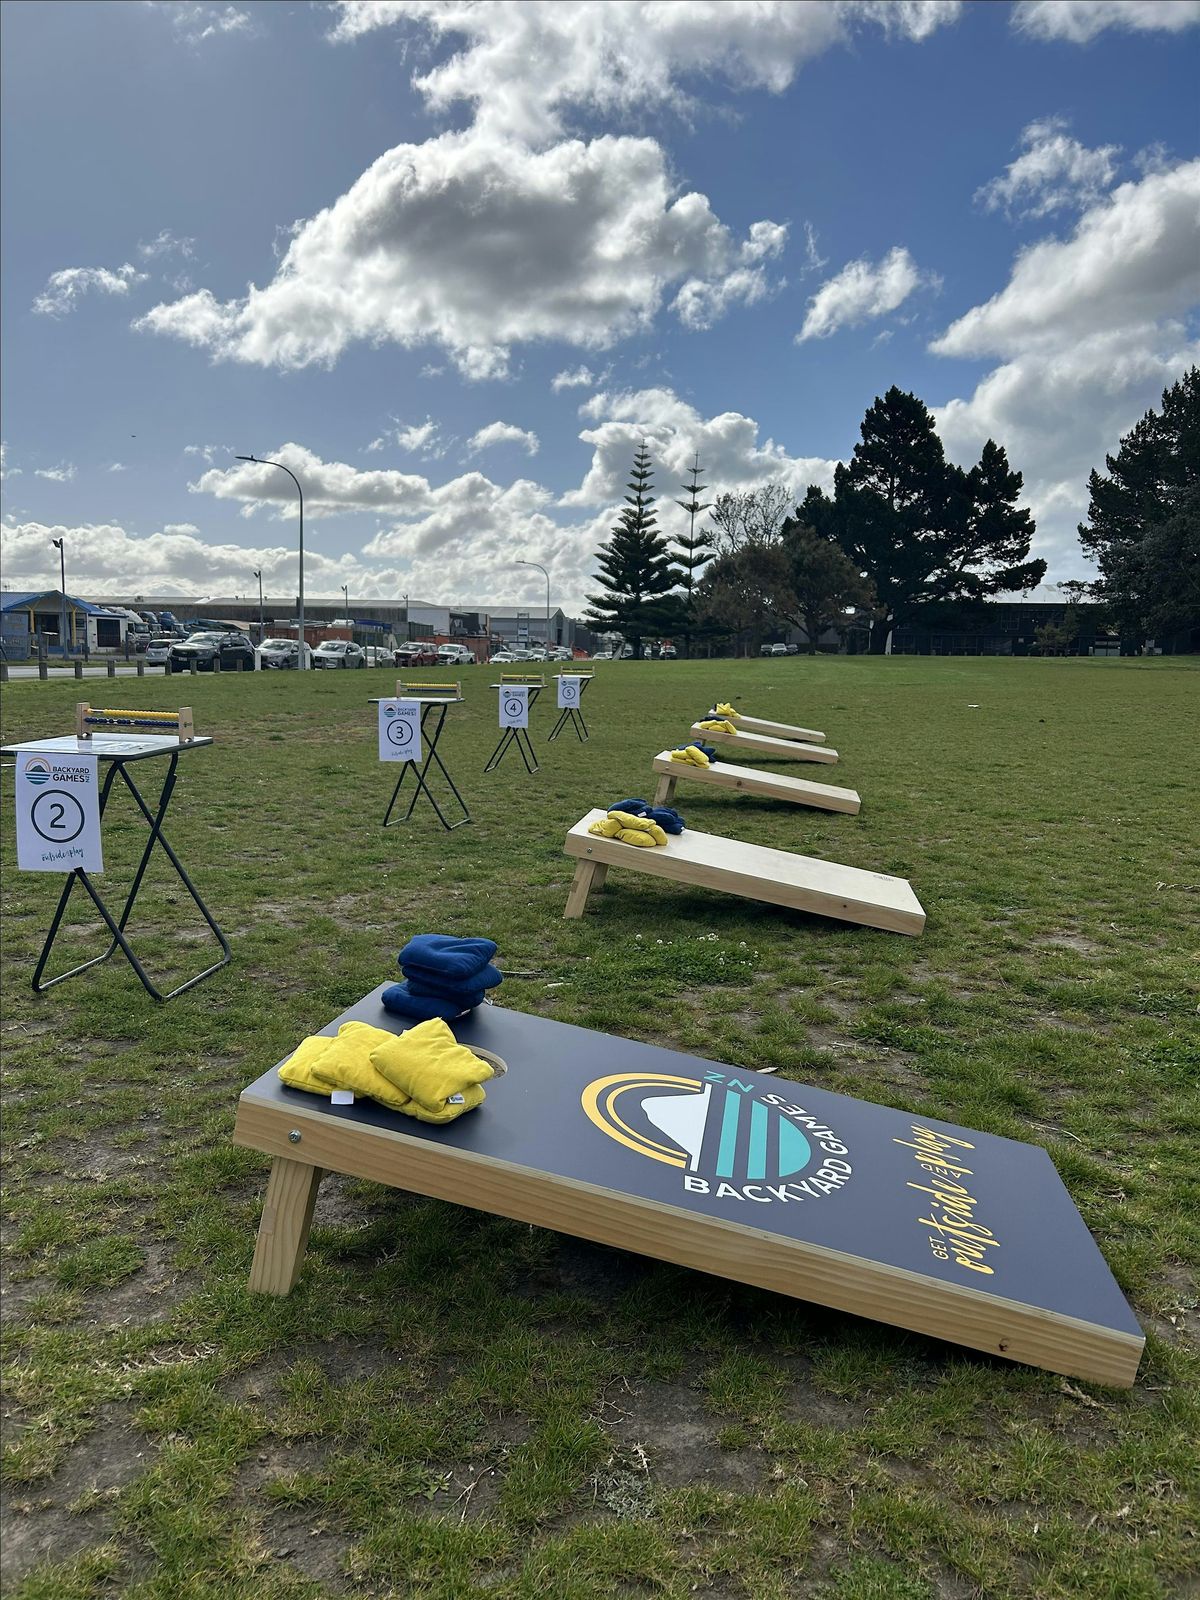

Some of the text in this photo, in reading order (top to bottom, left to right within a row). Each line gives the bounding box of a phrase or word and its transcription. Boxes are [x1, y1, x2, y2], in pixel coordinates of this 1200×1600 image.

[510, 703, 517, 712] 4
[396, 726, 404, 739] 3
[52, 766, 90, 774] BACKYARD
[52, 773, 85, 783] GAMES
[50, 803, 66, 829] 2
[683, 1070, 853, 1203] BACKYARD GAMES NZ
[892, 1122, 1001, 1275] outside AND play
[929, 1236, 949, 1260] GET
